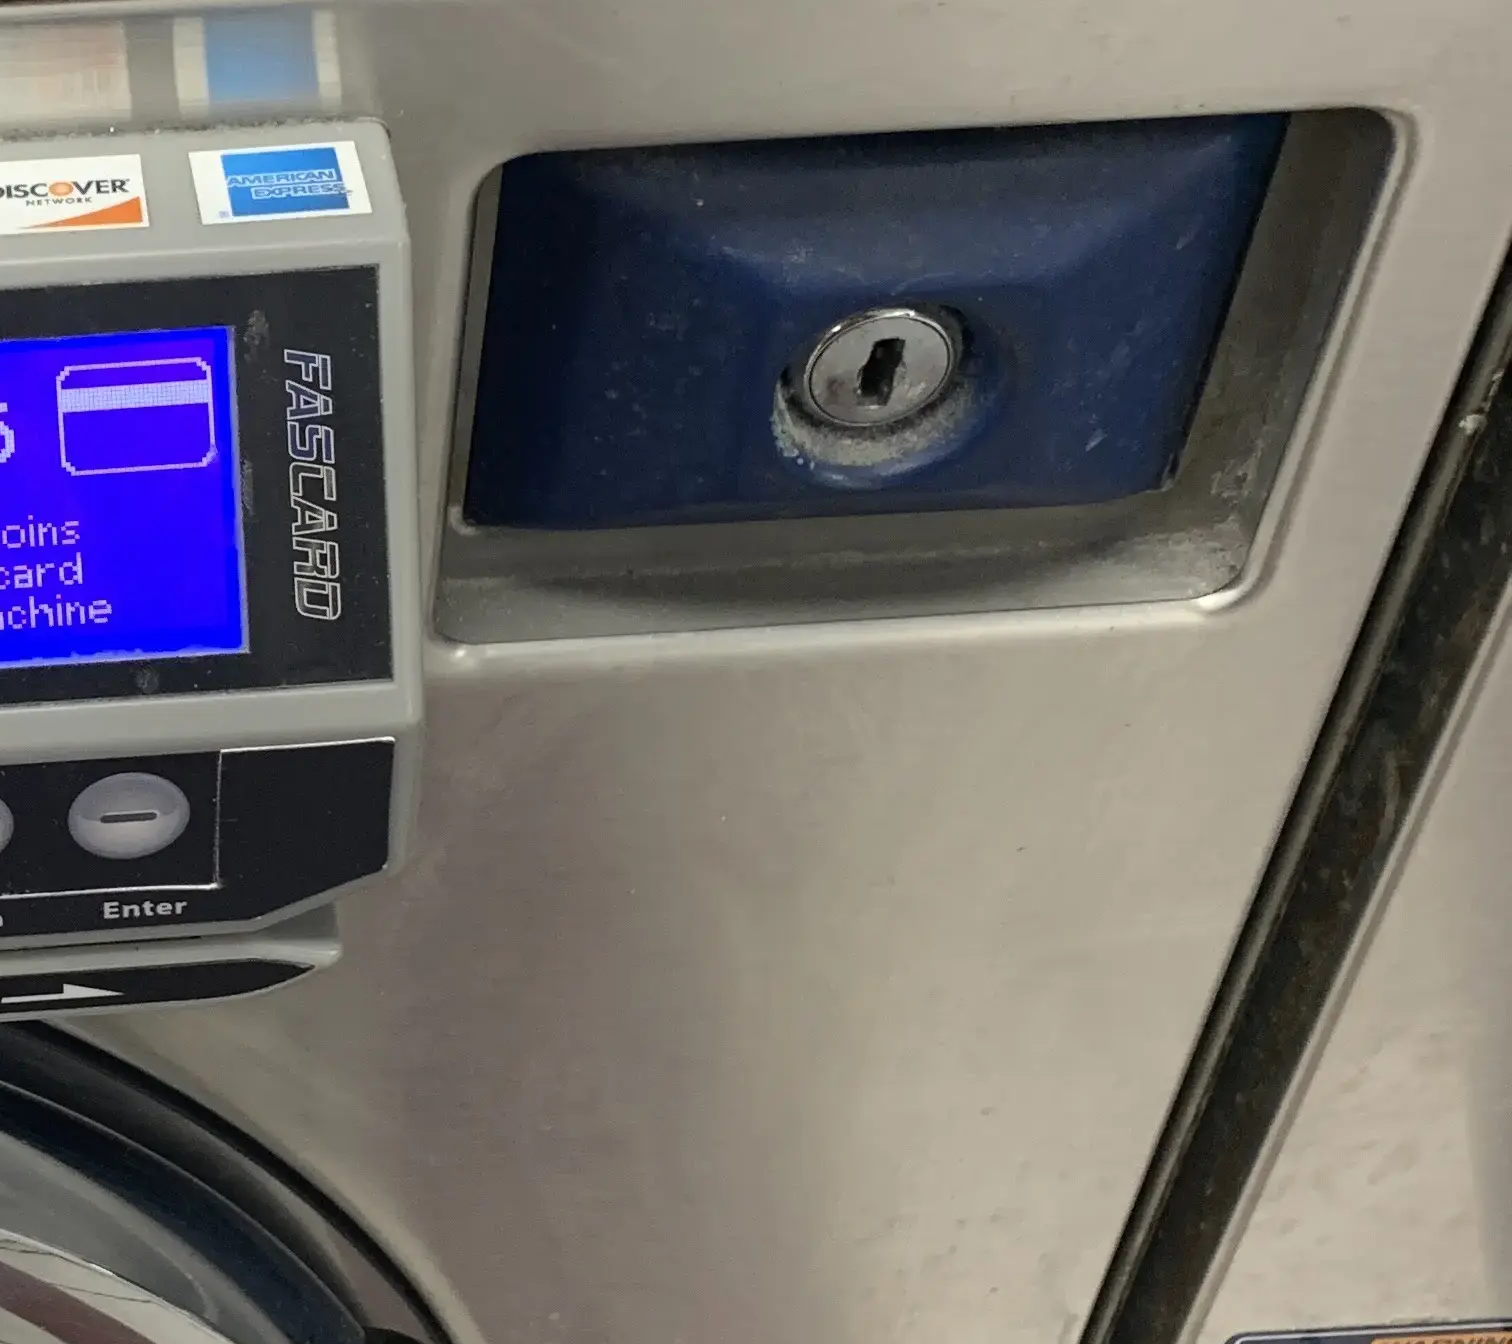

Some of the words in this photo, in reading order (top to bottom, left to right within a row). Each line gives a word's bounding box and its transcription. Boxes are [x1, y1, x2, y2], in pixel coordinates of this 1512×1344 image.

[228, 170, 334, 186] AMERICAN
[253, 183, 347, 198] EXPRESS
[26, 197, 92, 206] NETWORK
[284, 348, 344, 622] FASCARD
[102, 896, 187, 920] Enter
